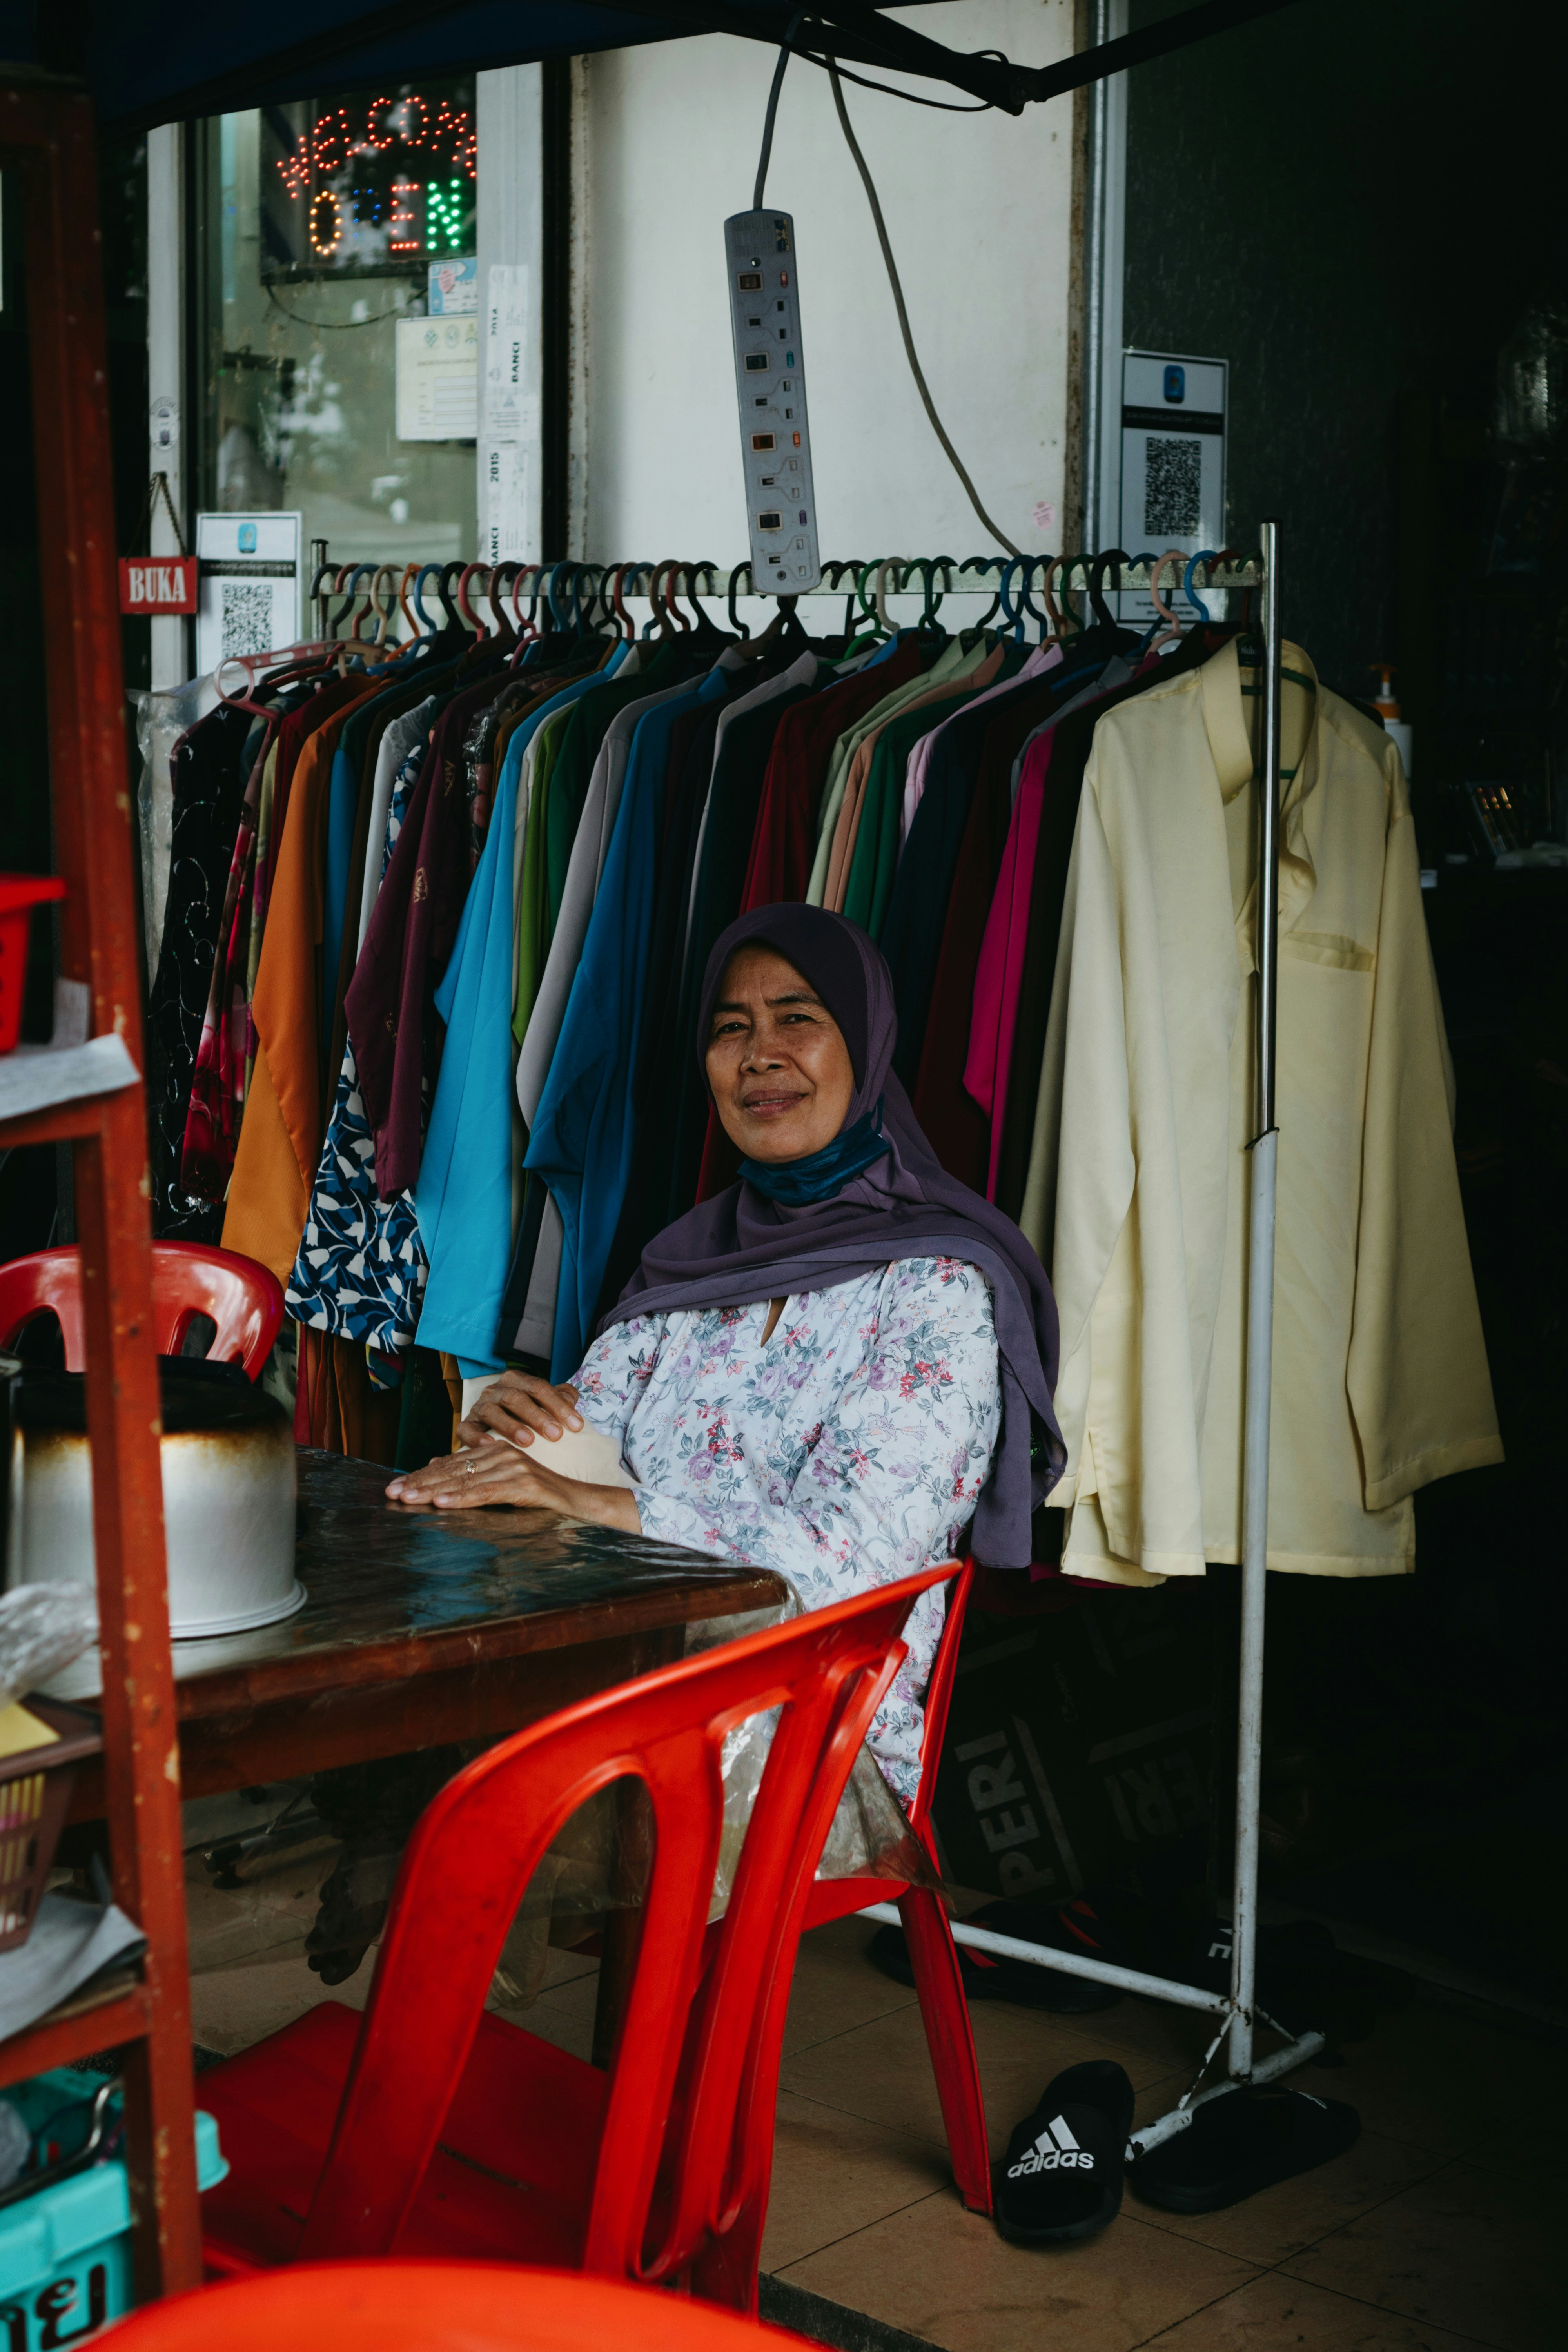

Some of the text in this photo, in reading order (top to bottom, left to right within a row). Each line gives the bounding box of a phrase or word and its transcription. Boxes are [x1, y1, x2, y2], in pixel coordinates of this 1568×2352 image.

[309, 177, 461, 256] OPEN
[512, 341, 520, 383] BANCI
[490, 452, 499, 482] 2015
[128, 566, 187, 603] BUKA
[954, 1730, 1056, 1898] PERI
[1007, 2150, 1094, 2178] adidas
